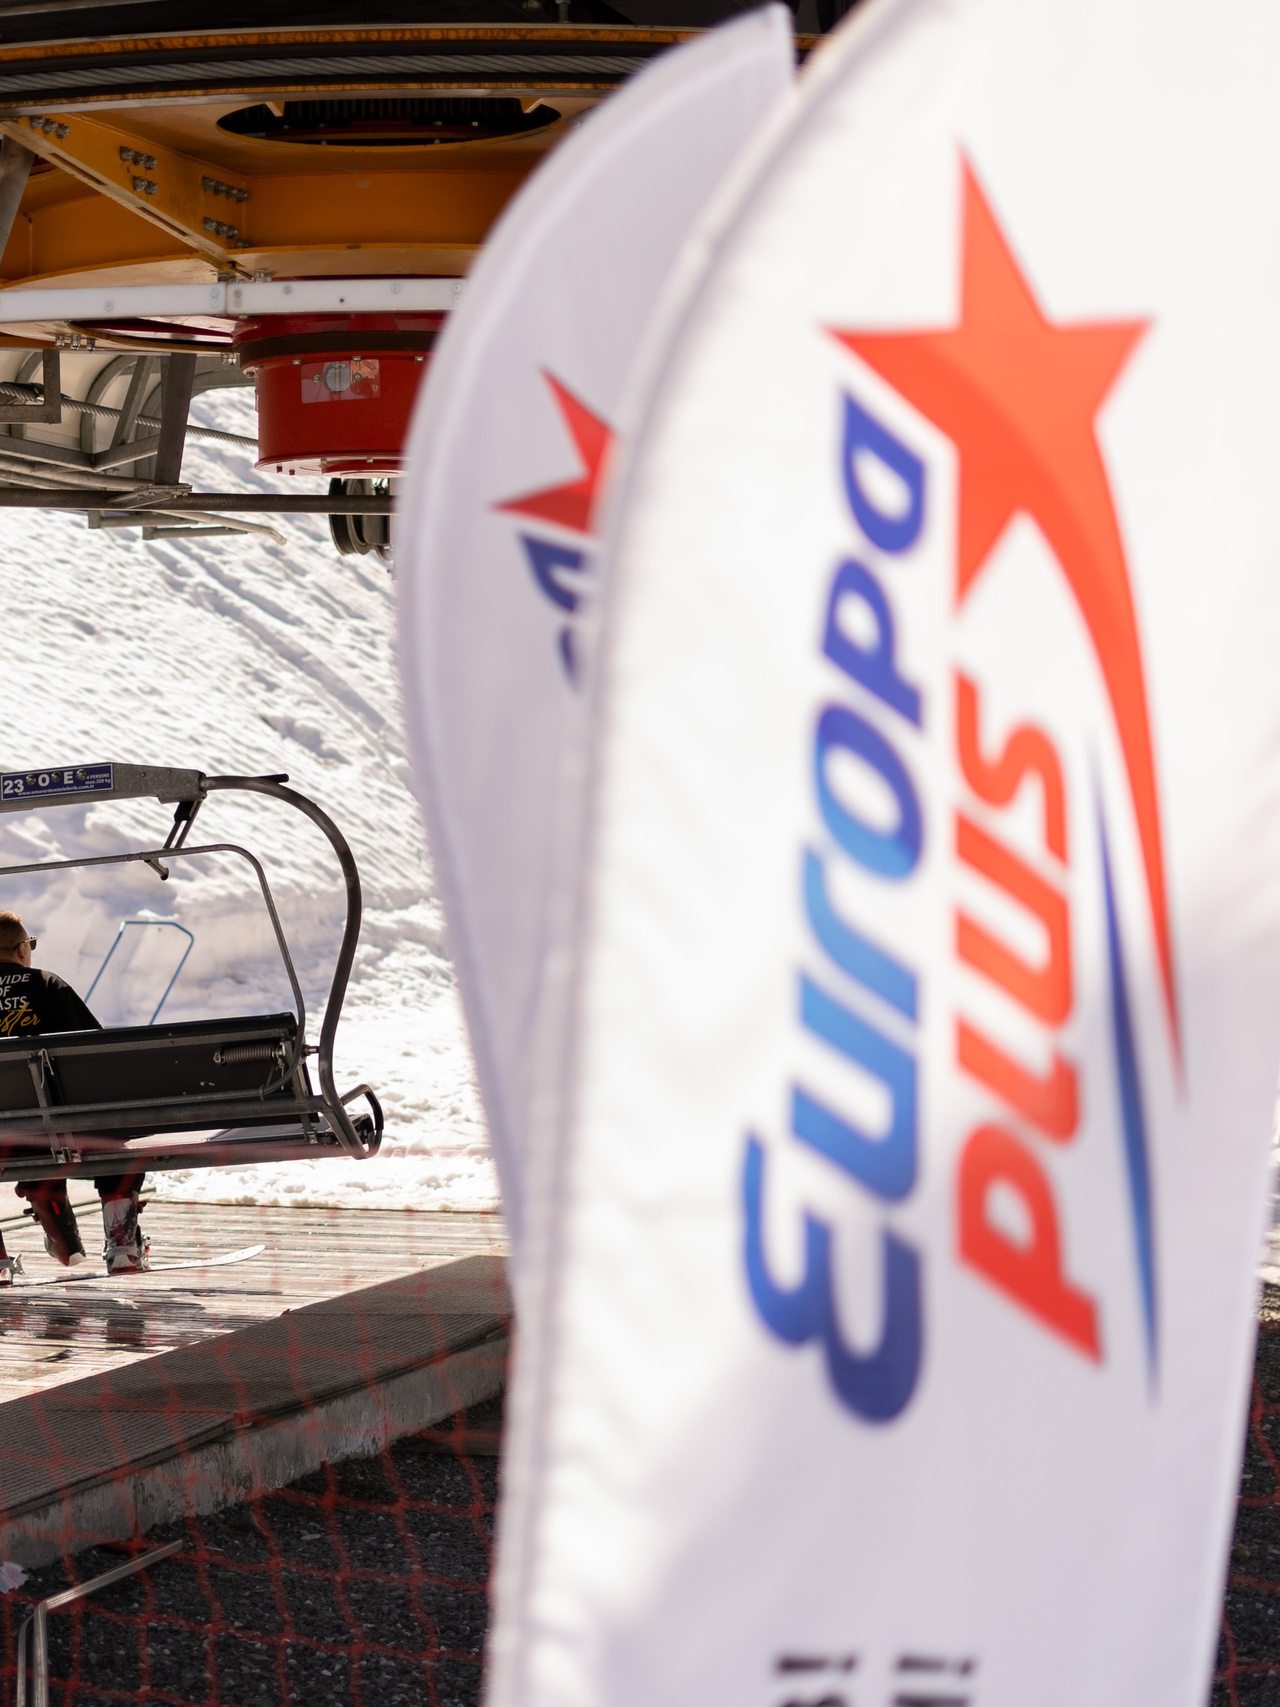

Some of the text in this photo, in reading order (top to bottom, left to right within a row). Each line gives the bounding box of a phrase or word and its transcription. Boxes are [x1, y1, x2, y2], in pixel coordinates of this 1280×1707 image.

[3, 771, 74, 795] 23 O E
